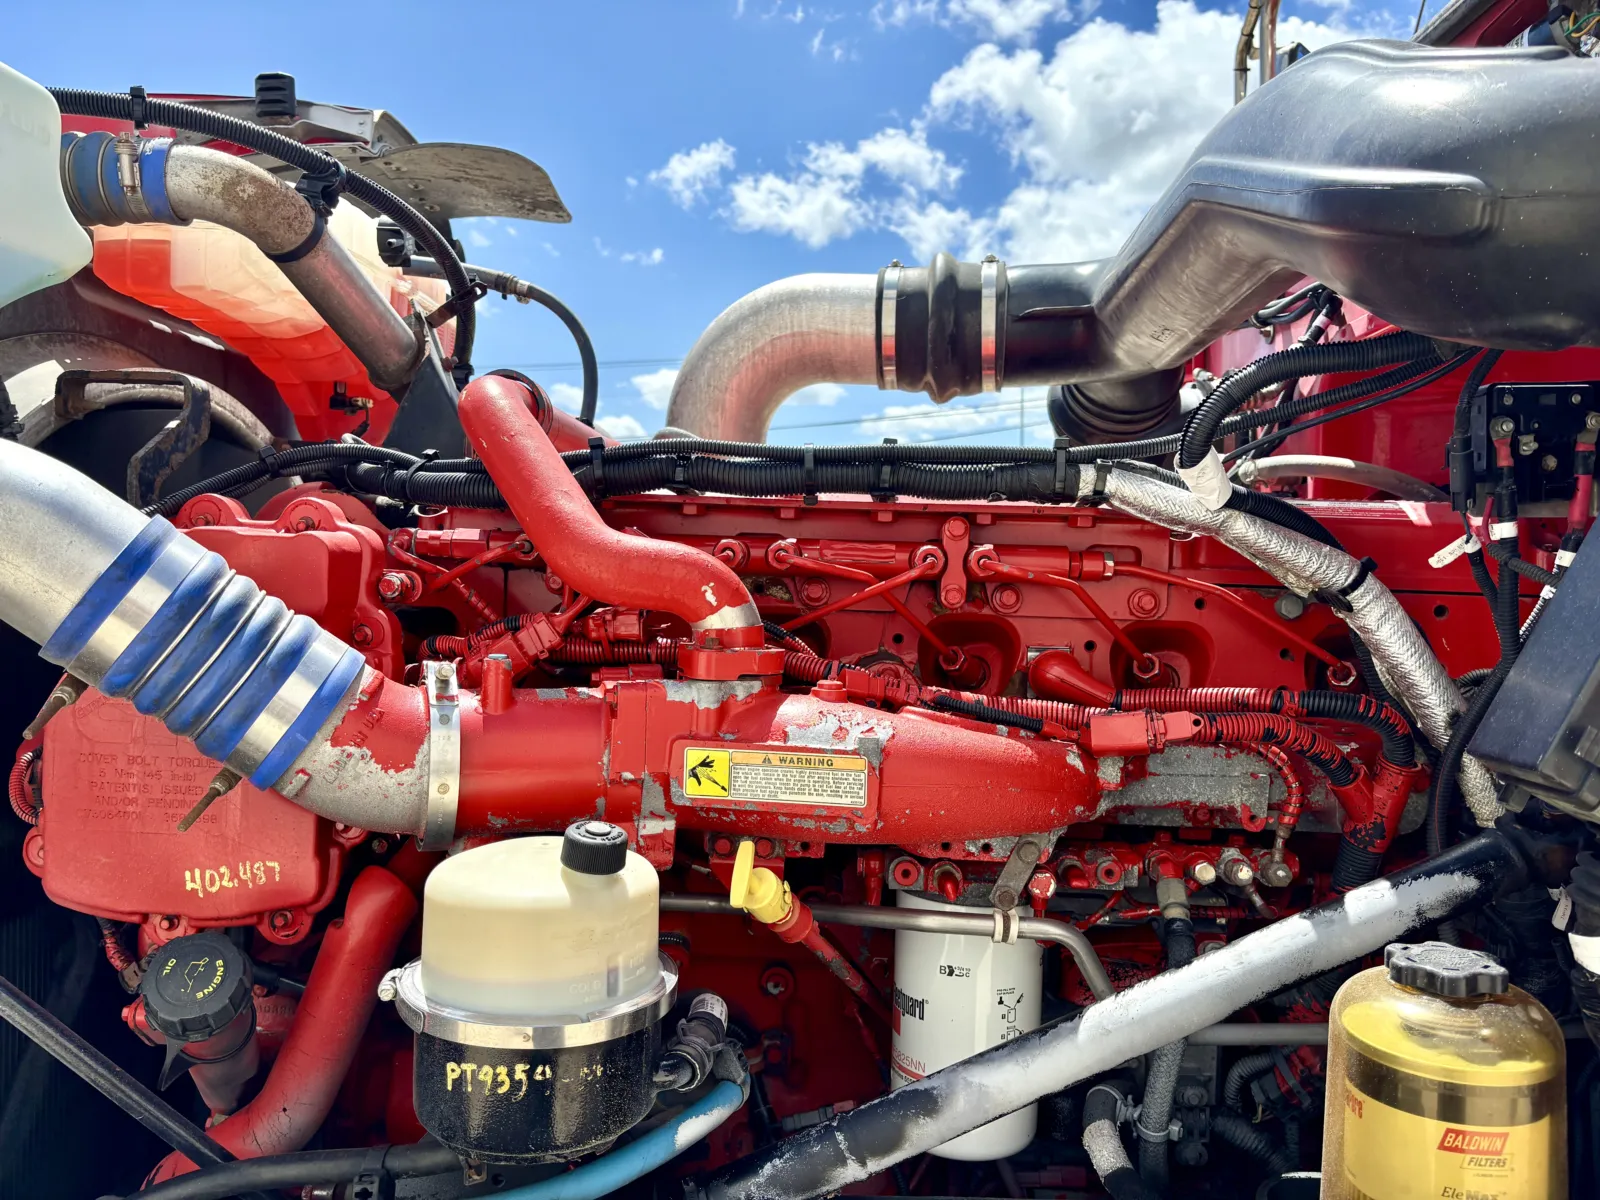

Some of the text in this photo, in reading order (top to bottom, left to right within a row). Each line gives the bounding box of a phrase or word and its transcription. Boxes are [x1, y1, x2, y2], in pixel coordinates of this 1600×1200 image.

[80, 752, 118, 764] COVER
[127, 755, 159, 766] BOLT
[778, 756, 834, 767] WARNING
[161, 785, 204, 796] ISSUED
[95, 795, 139, 808] AND/OR
[185, 861, 280, 898] 402.487
[162, 958, 177, 977] OIL
[940, 964, 946, 974] B
[196, 960, 224, 999] ENGINE
[1444, 1132, 1504, 1152] BALDWIN
[1468, 1156, 1508, 1168] FILTERS
